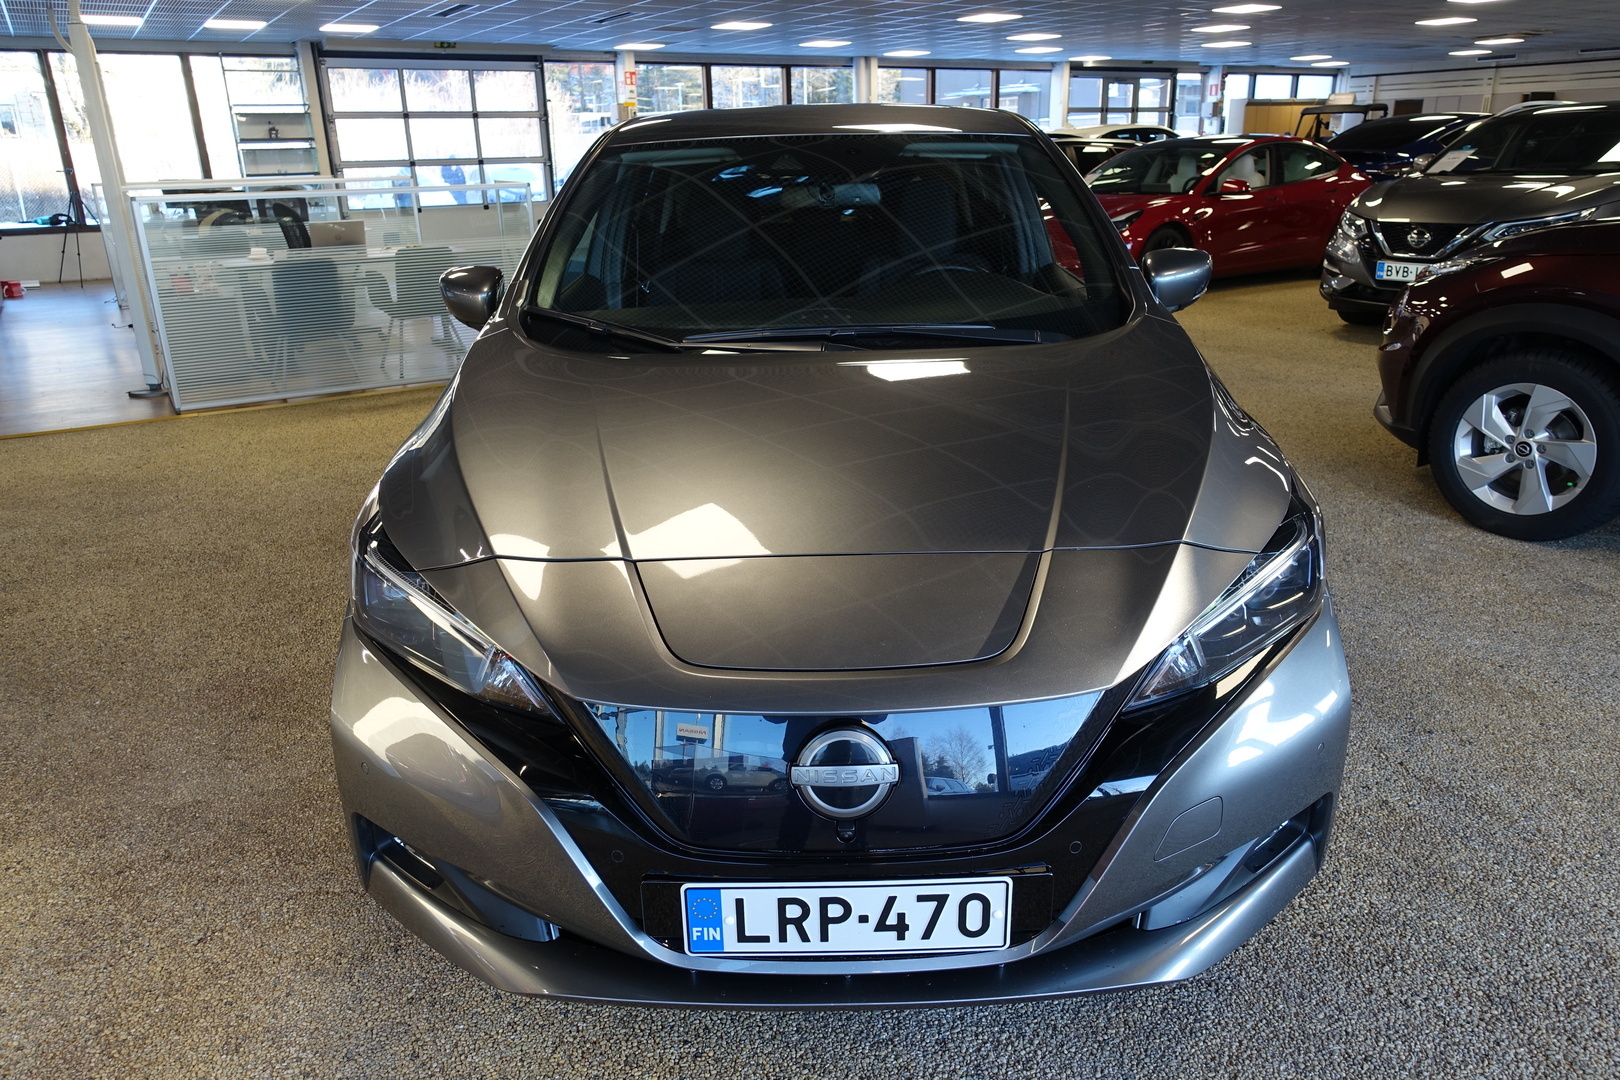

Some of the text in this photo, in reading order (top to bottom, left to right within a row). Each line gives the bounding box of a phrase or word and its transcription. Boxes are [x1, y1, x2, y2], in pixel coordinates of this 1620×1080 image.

[793, 766, 897, 784] NISSAN
[735, 892, 991, 944] LRP-470
[692, 927, 721, 941] FIN
